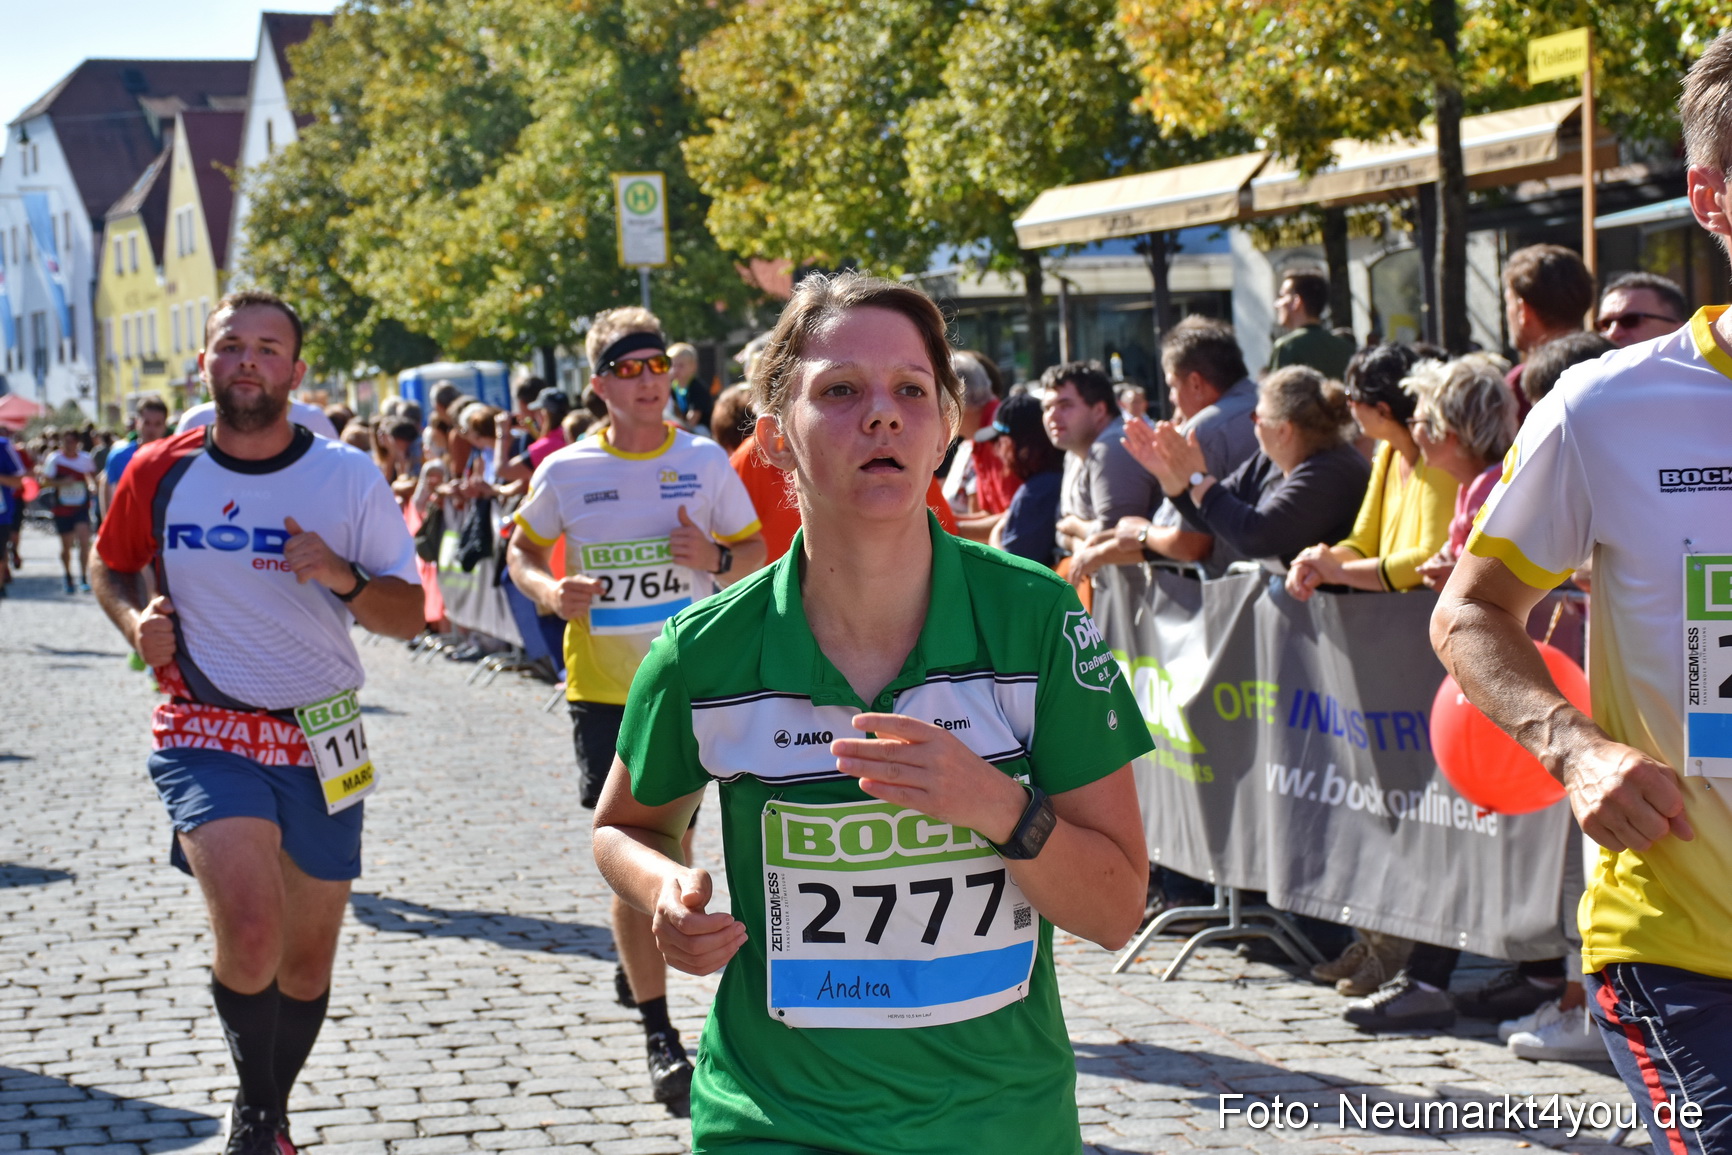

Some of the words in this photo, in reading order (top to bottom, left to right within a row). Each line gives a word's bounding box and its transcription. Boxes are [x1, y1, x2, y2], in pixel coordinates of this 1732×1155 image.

[1659, 467, 1732, 486] BOCK
[599, 568, 680, 602] 2764
[933, 716, 971, 730] Semi
[794, 730, 834, 746] JAKO
[798, 868, 1006, 946] 2777
[817, 970, 891, 1000] Andrea
